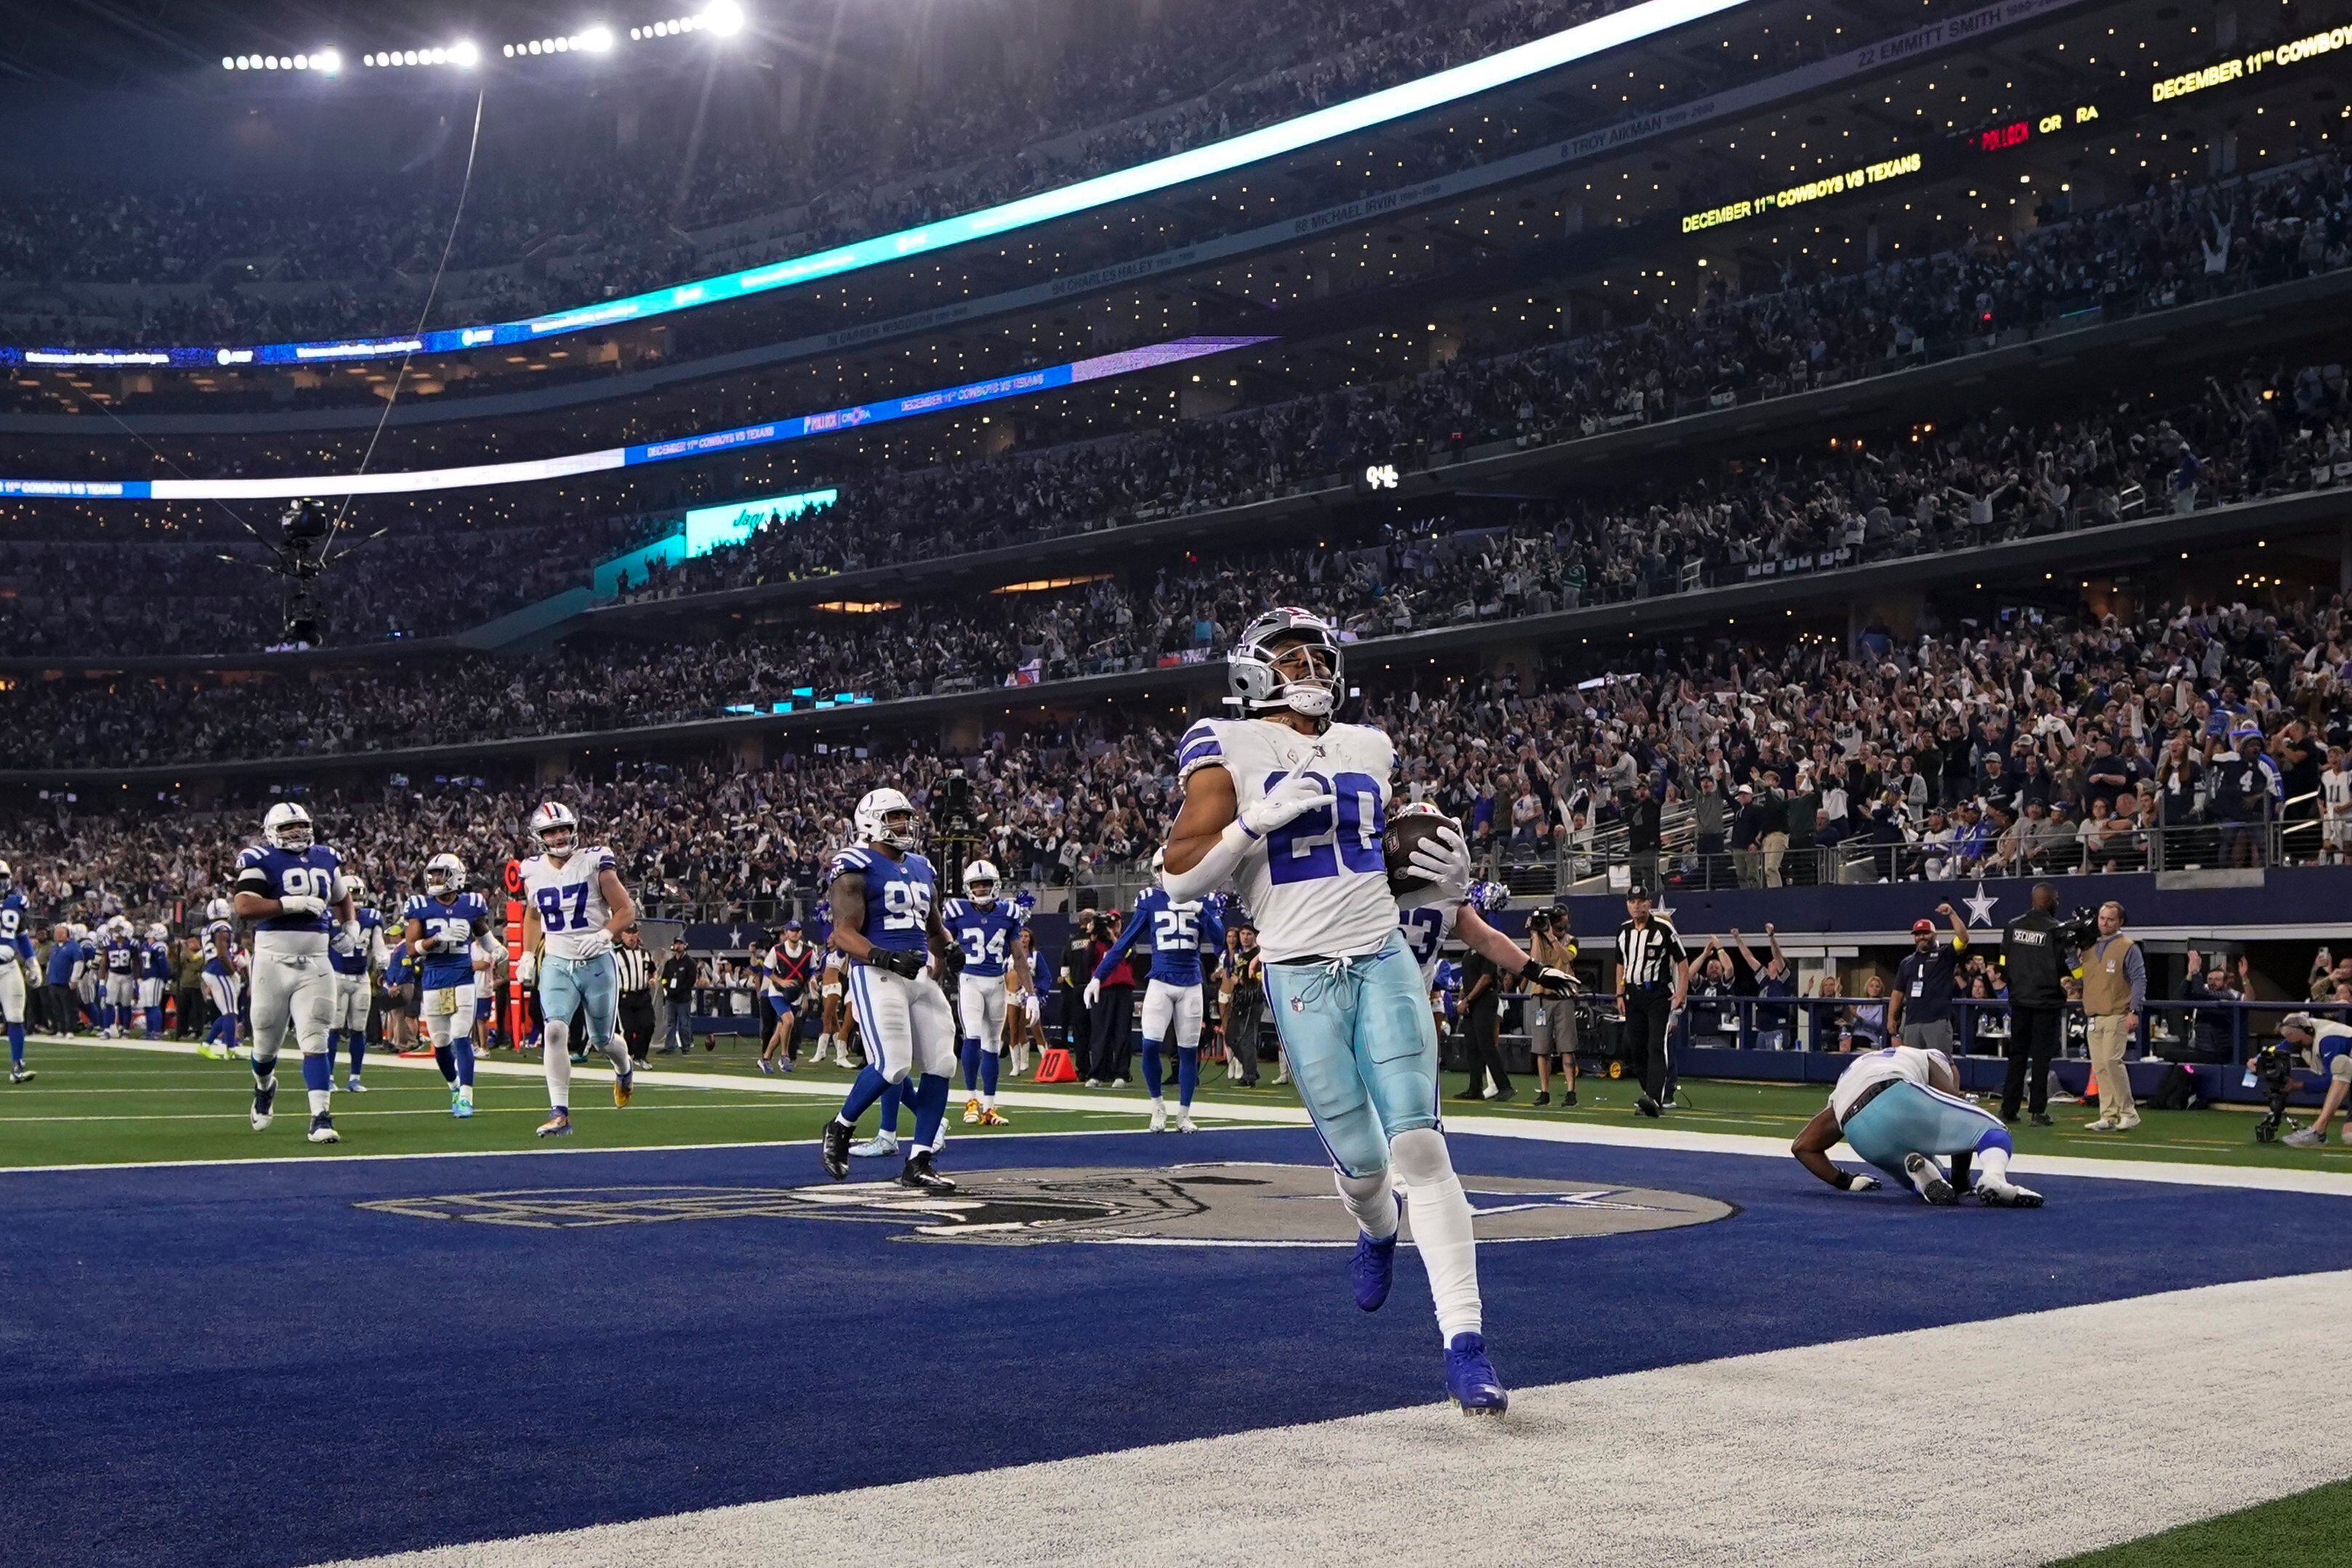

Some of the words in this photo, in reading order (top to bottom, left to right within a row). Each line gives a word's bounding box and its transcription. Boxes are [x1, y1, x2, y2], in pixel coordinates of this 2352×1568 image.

[1858, 50, 1874, 68] 22
[1880, 26, 1943, 60] EMMITT
[1949, 8, 2002, 36] SMITH
[2152, 59, 2243, 102] DECEMBER
[1560, 145, 1568, 158] 8
[1572, 133, 1606, 155] TROY
[1608, 116, 1662, 143] AIKMAN
[2039, 114, 2062, 134] OR
[2076, 105, 2099, 124] RA
[1682, 201, 1751, 233] DECEMBER
[1777, 175, 1843, 208] COWBOYS
[1845, 169, 1864, 189] VS
[1865, 153, 1921, 183] TEXANS
[1311, 205, 1361, 229] MICHAEL
[1365, 194, 1397, 214] IRVIN
[1118, 259, 1153, 279] HALEY
[901, 394, 943, 411] DECEMBER
[958, 381, 1000, 400] COWBOYS
[1000, 380, 1011, 392] VS
[1012, 373, 1044, 389] TEXANS
[647, 441, 686, 458] DECEMBER
[699, 432, 735, 448] COWBOYS
[736, 430, 745, 442] VS
[746, 426, 775, 440] TEXANS
[2239, 770, 2253, 792] 4
[2328, 784, 2341, 803] 11
[1264, 770, 1387, 885] 20
[1063, 844, 1074, 858] 21
[282, 867, 332, 902] 90
[537, 881, 589, 931] 87
[962, 927, 1007, 965] 34
[1154, 910, 1201, 950] 25
[2014, 930, 2045, 944] SECURITY
[1039, 1053, 1060, 1078] 10
